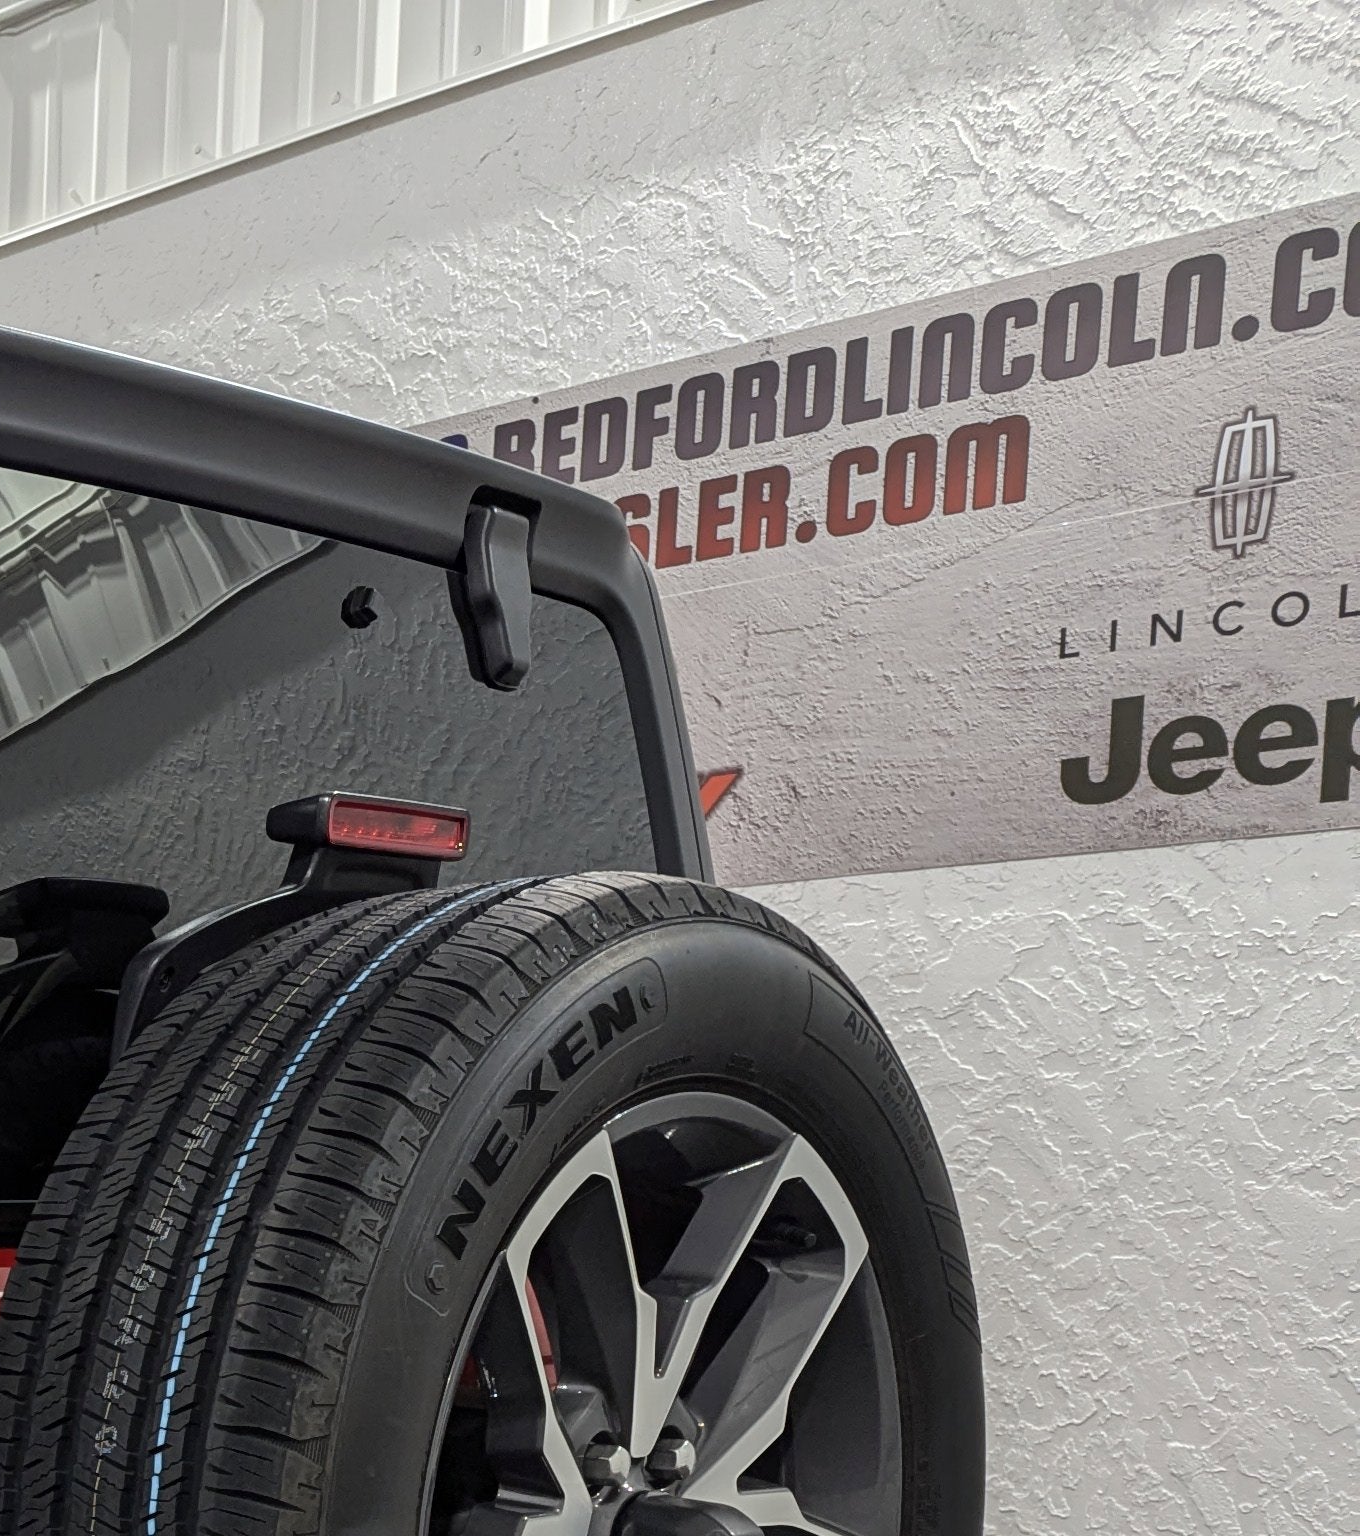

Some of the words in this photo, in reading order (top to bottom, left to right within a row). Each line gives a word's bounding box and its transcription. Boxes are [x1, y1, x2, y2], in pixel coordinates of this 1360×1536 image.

[493, 221, 1360, 485] BEDFORDLINCOLN.C
[435, 985, 638, 1261] NEXEN
[842, 1009, 935, 1153] All-Weather
